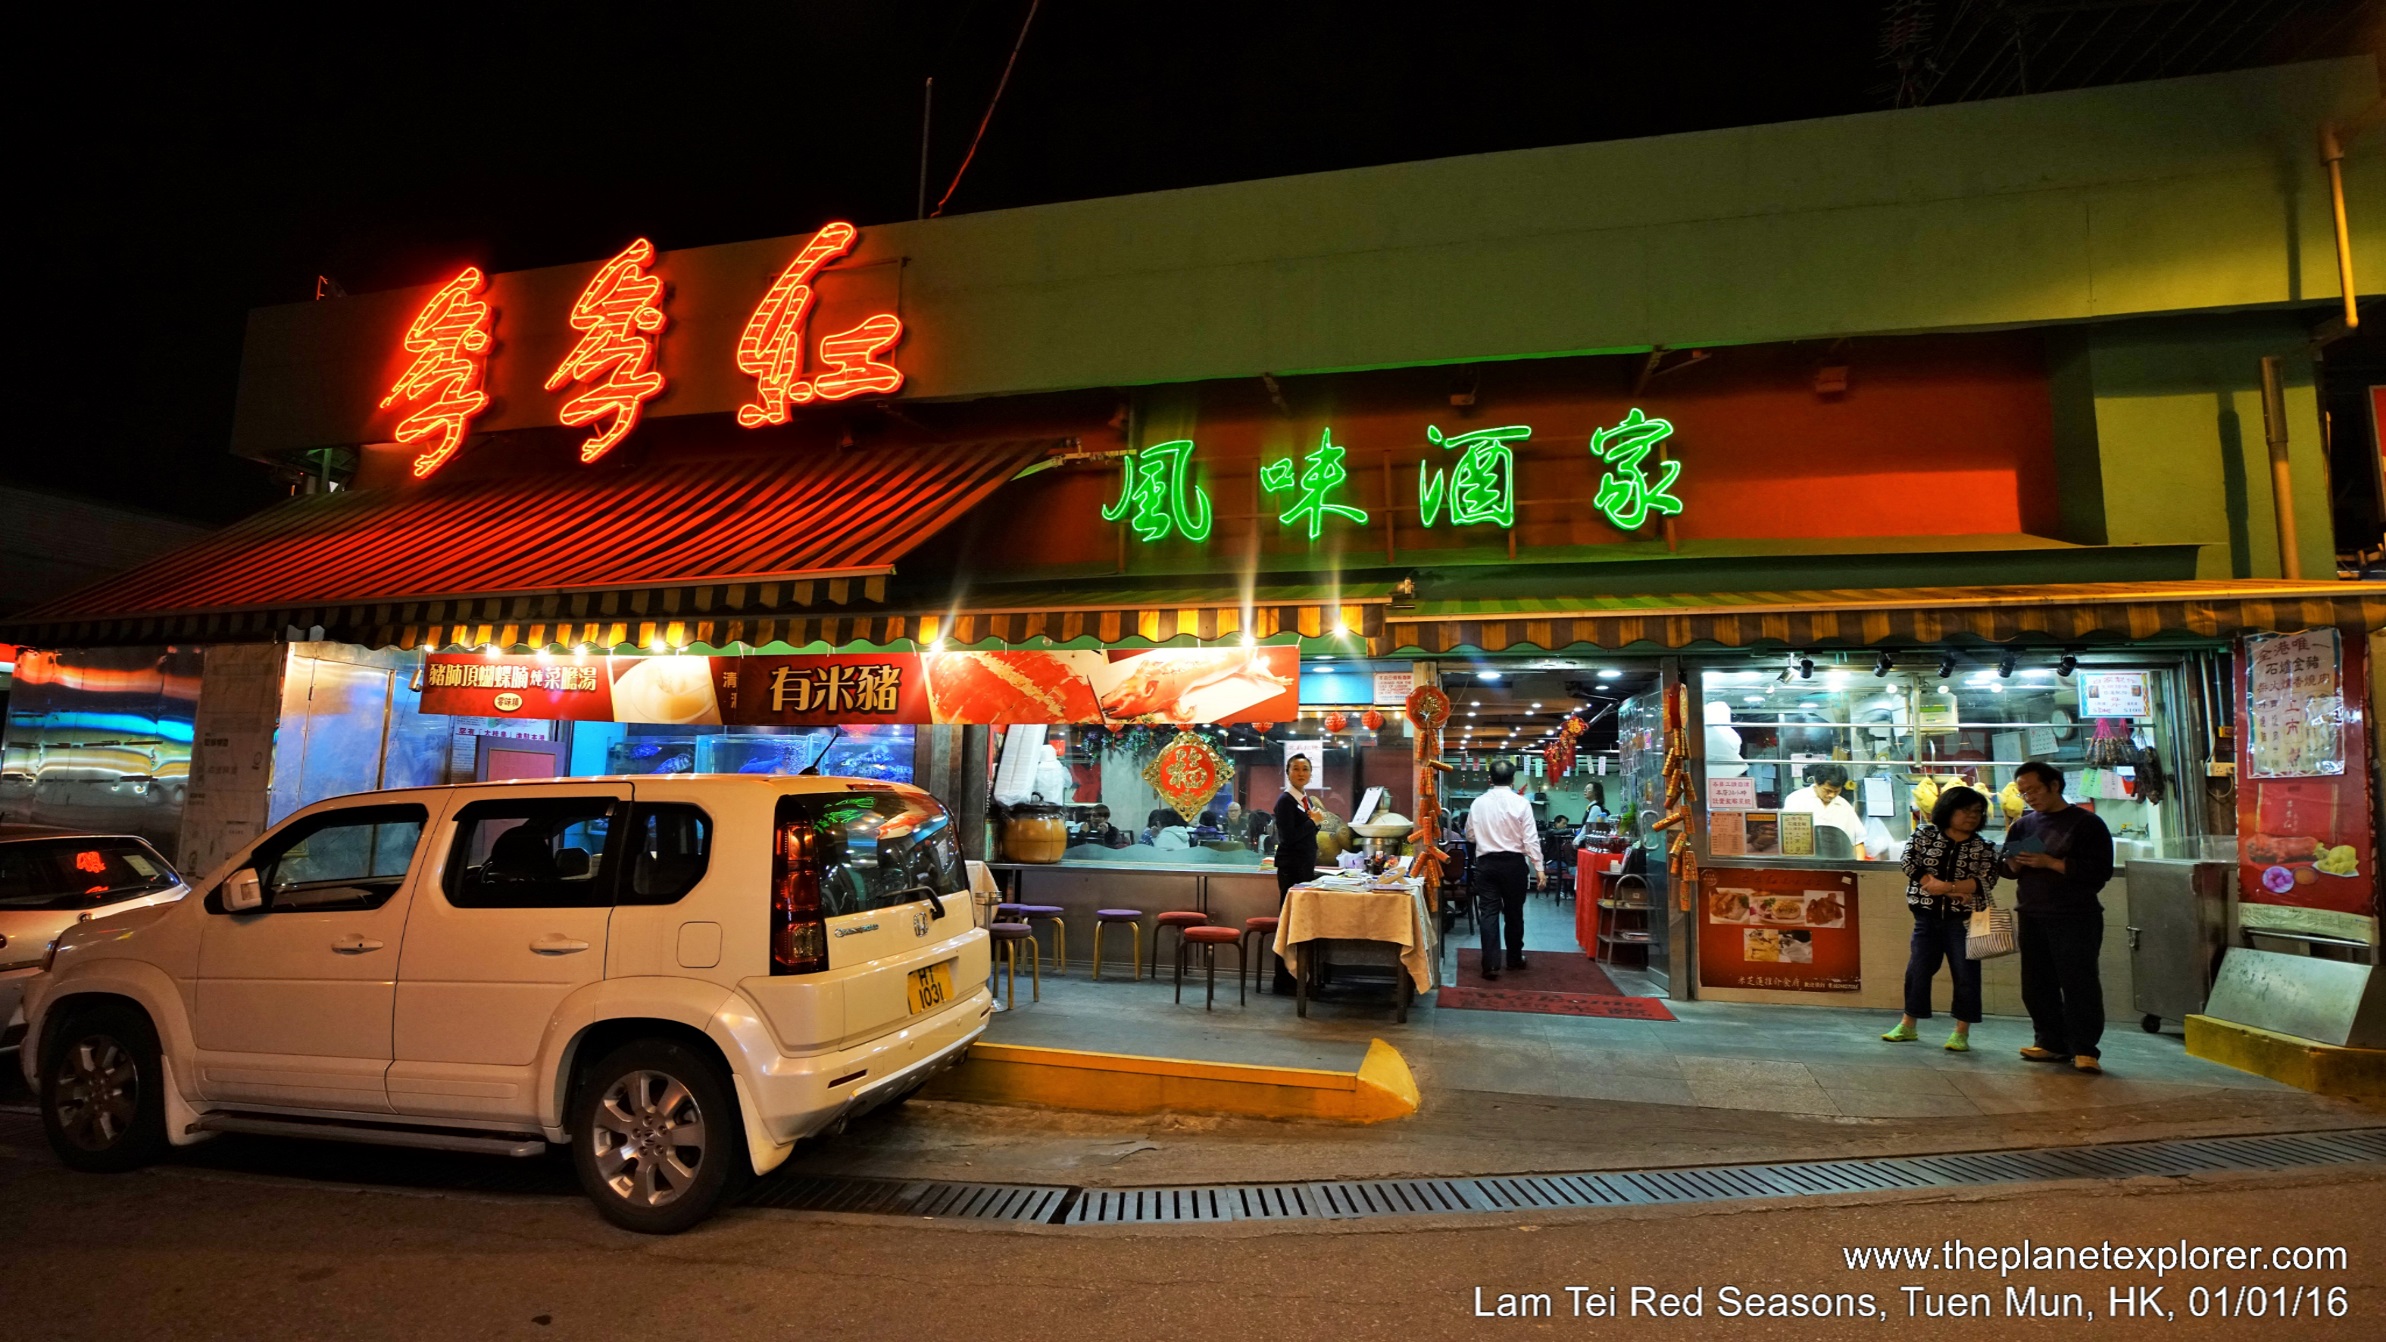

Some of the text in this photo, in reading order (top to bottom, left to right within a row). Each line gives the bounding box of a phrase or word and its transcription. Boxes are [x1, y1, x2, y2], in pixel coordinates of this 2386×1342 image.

[1101, 408, 1684, 542] 風味酒家
[769, 664, 902, 712] 有米豬
[1166, 747, 1208, 789] 福
[918, 981, 945, 1009] 1031
